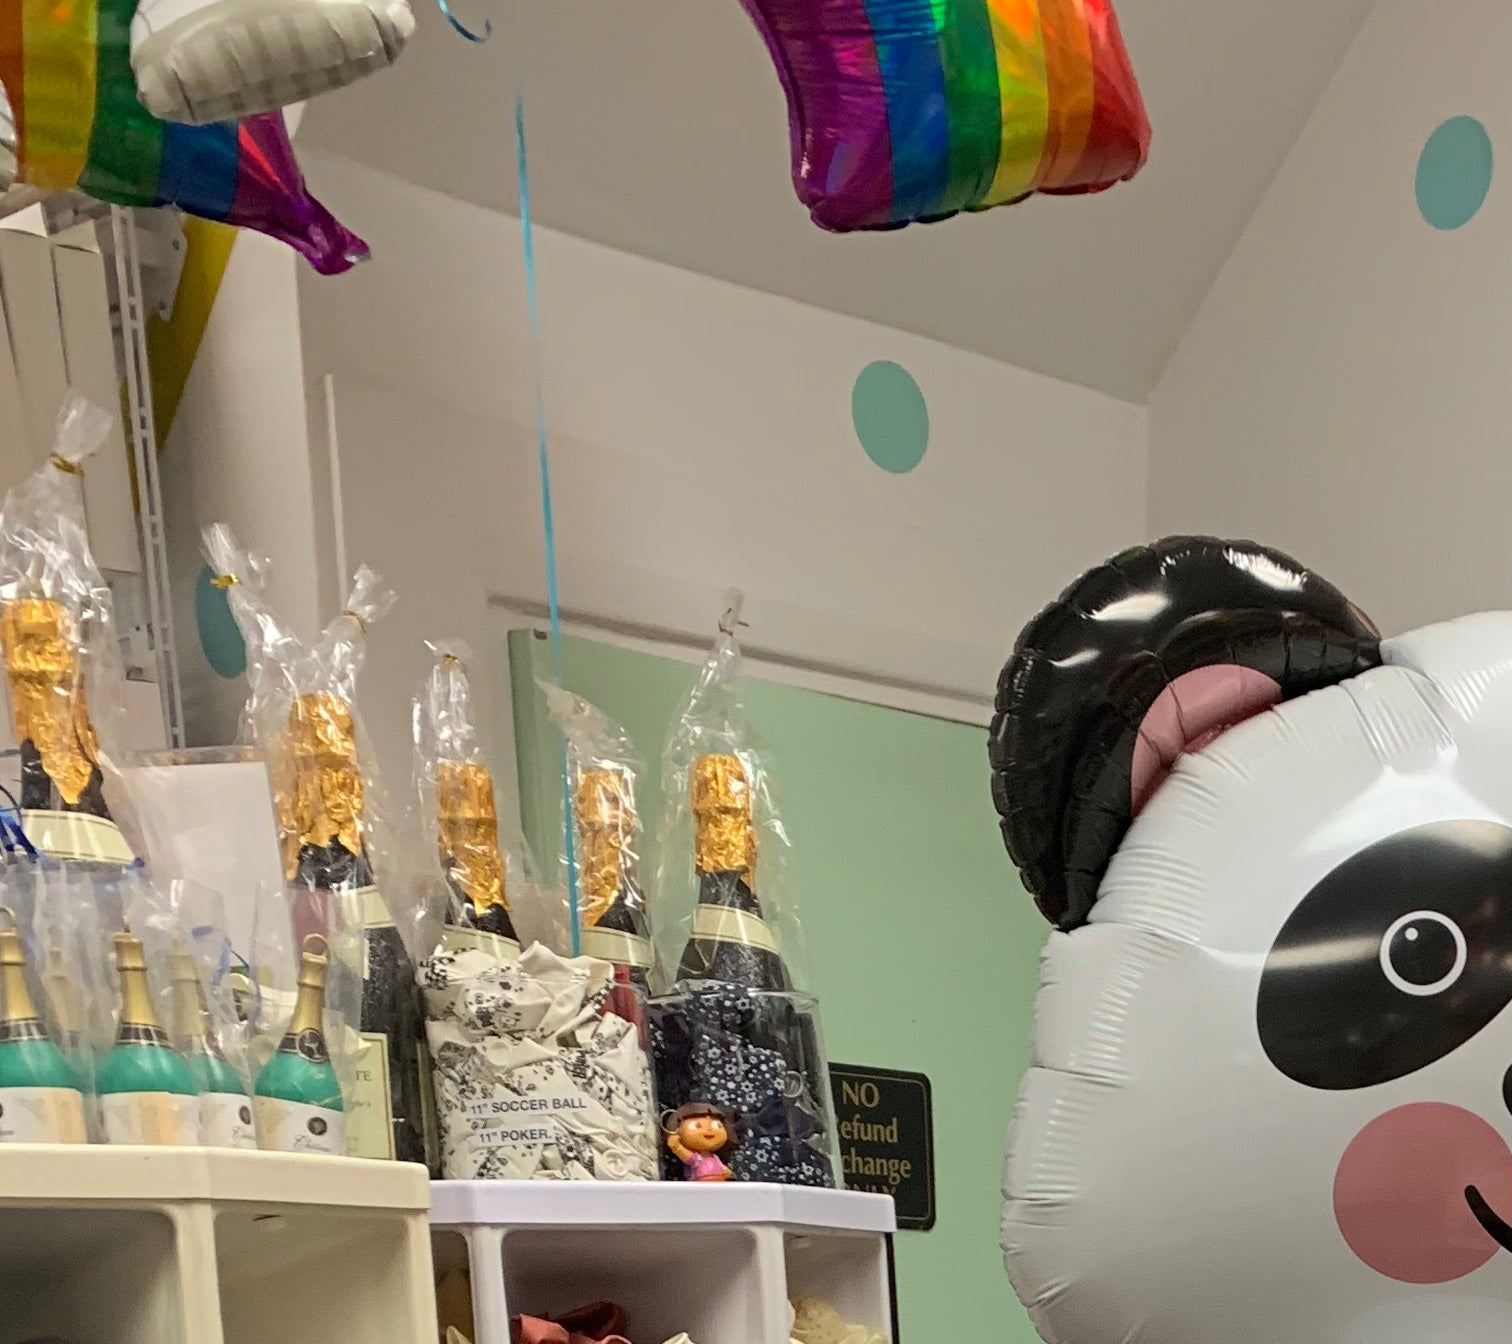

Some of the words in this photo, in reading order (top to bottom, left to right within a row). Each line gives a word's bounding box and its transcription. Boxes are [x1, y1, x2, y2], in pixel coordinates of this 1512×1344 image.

[491, 1098, 549, 1114] SOCCER
[552, 1097, 587, 1110] BALL
[842, 1080, 881, 1108] NO
[841, 1113, 899, 1145] efund
